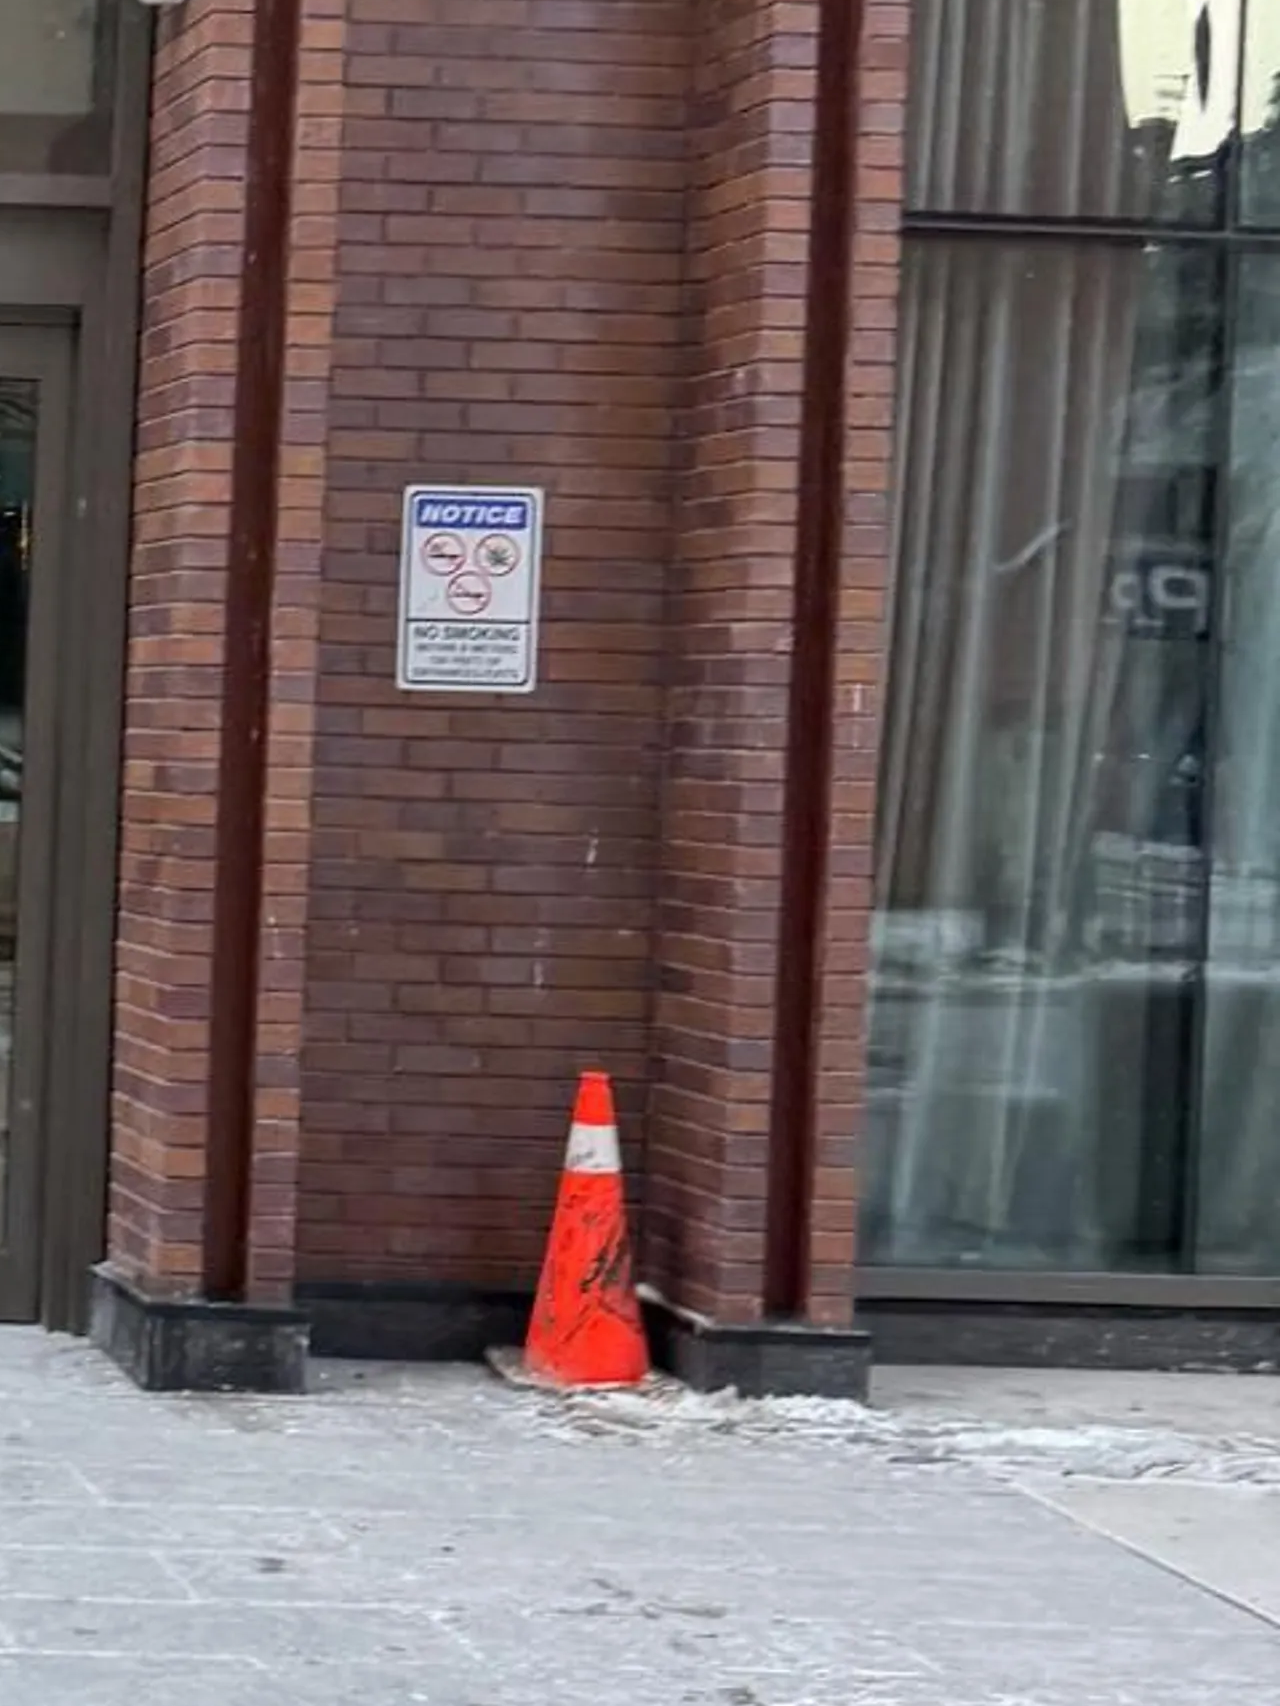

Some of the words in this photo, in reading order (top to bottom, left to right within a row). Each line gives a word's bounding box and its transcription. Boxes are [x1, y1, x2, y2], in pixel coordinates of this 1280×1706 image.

[420, 504, 524, 525] NOTICE
[413, 625, 439, 640] NO
[443, 626, 521, 641] SMOKING
